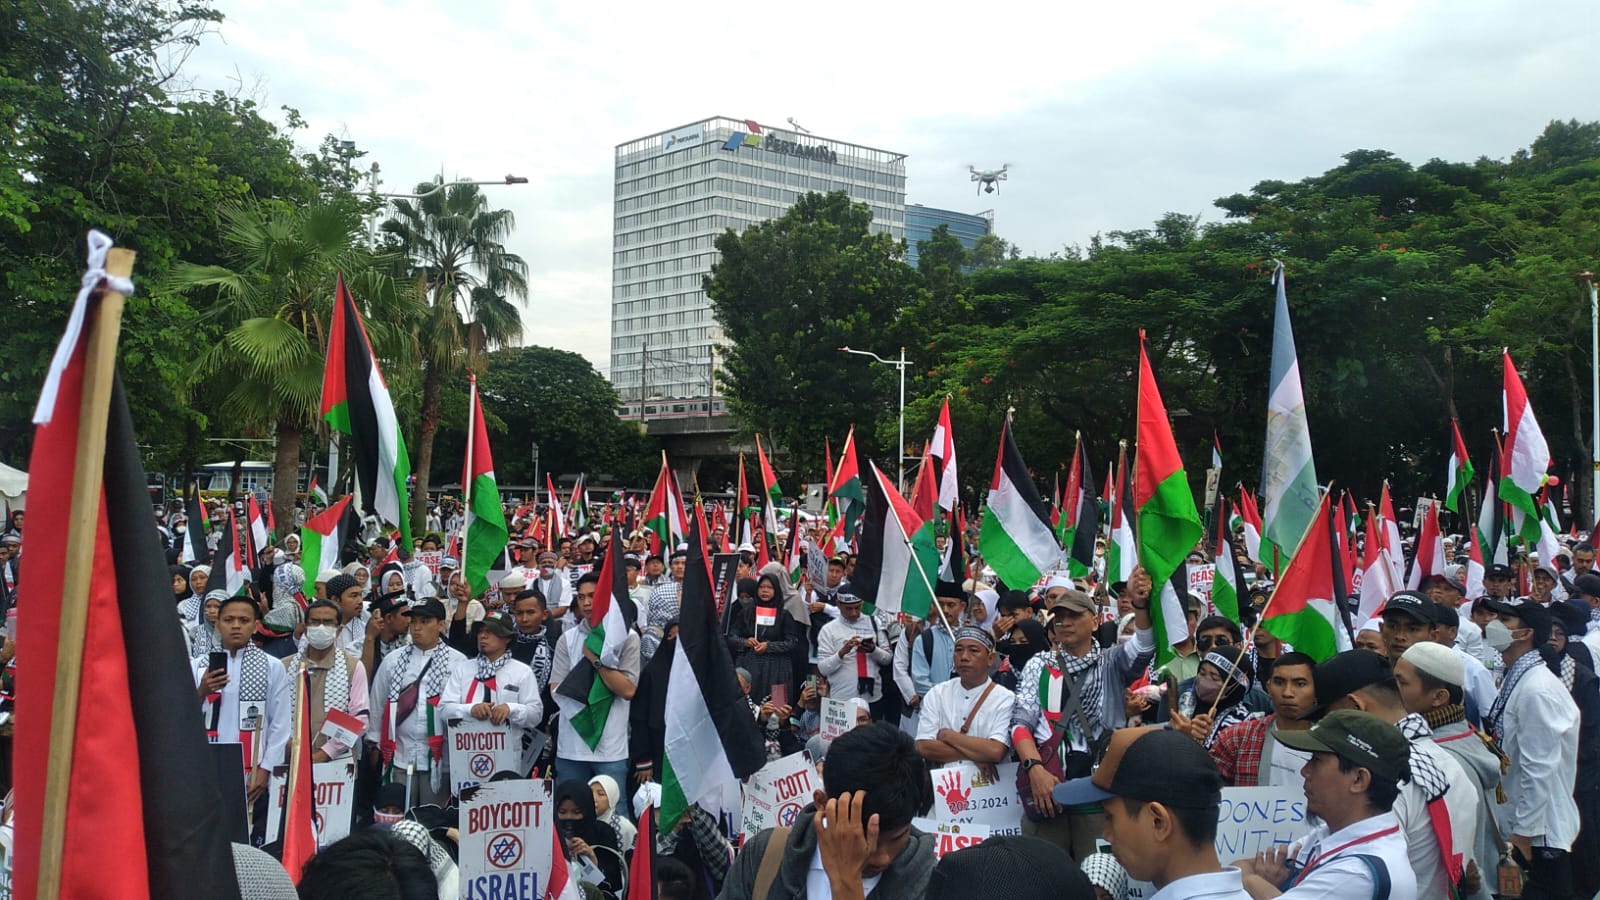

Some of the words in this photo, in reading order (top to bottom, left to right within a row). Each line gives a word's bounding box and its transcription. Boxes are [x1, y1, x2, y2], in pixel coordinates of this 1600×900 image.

[765, 134, 838, 163] PERTAMINA
[1190, 569, 1215, 584] CEAS
[828, 706, 838, 717] this
[839, 708, 846, 719] is
[455, 732, 506, 751] BOYCOTT
[278, 782, 345, 808] BOTT
[768, 769, 811, 803] YCOTT
[752, 806, 764, 823] Free
[950, 796, 1009, 812] 2023/2024
[1218, 799, 1305, 824] DONES
[468, 801, 543, 834] BOYCOTT
[1215, 828, 1294, 855] WITH
[467, 872, 542, 900] ISRAEL
